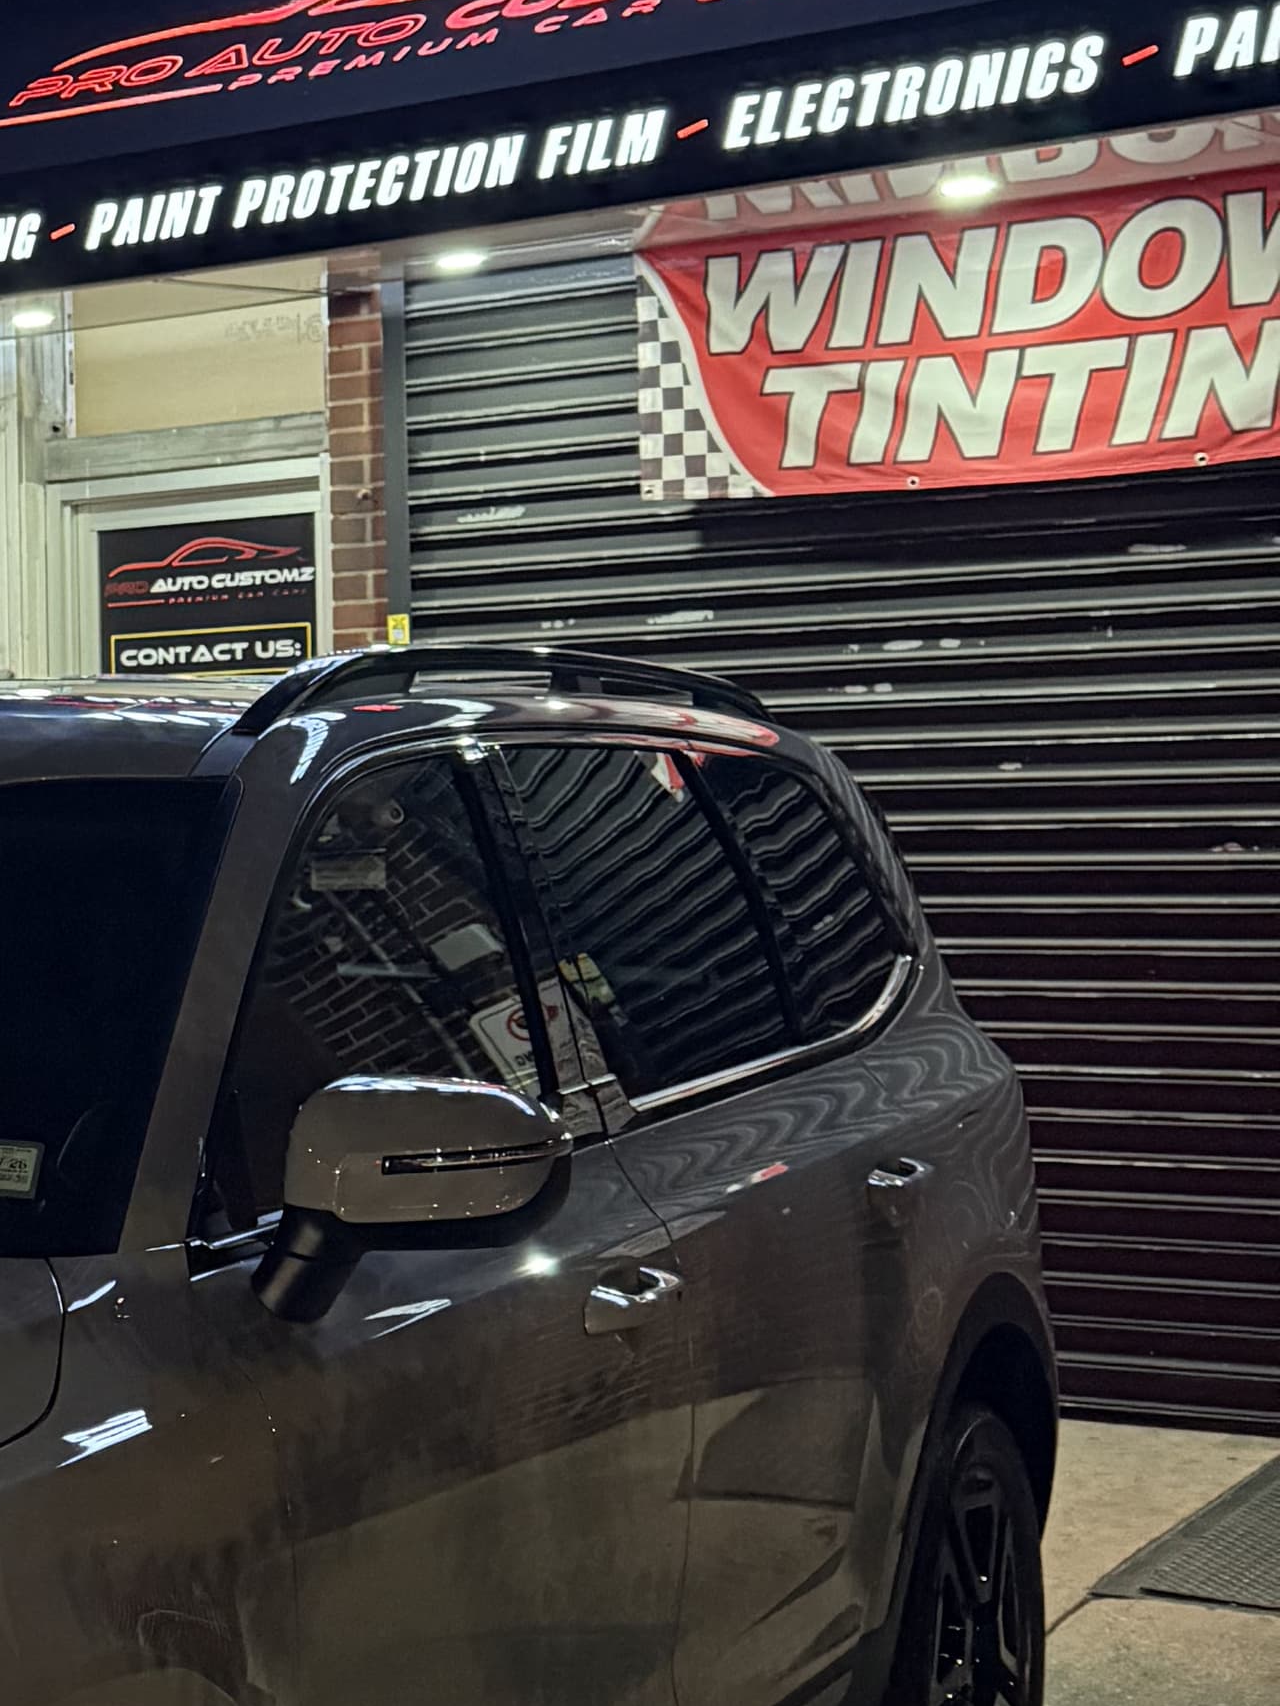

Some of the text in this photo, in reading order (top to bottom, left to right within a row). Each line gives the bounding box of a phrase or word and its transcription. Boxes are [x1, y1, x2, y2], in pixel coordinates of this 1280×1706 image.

[8, 52, 185, 107] PRO
[187, 11, 423, 79] AUTO
[228, 28, 498, 91] PREMIUM
[84, 184, 222, 252] PAINT
[236, 133, 525, 229] PROTECTION
[539, 108, 673, 186] FILM
[721, 33, 1106, 152] ELECTRONICS
[150, 575, 210, 594] AUTO
[210, 566, 316, 589] CUSTOMZ
[120, 638, 303, 667] CONTACT US:
